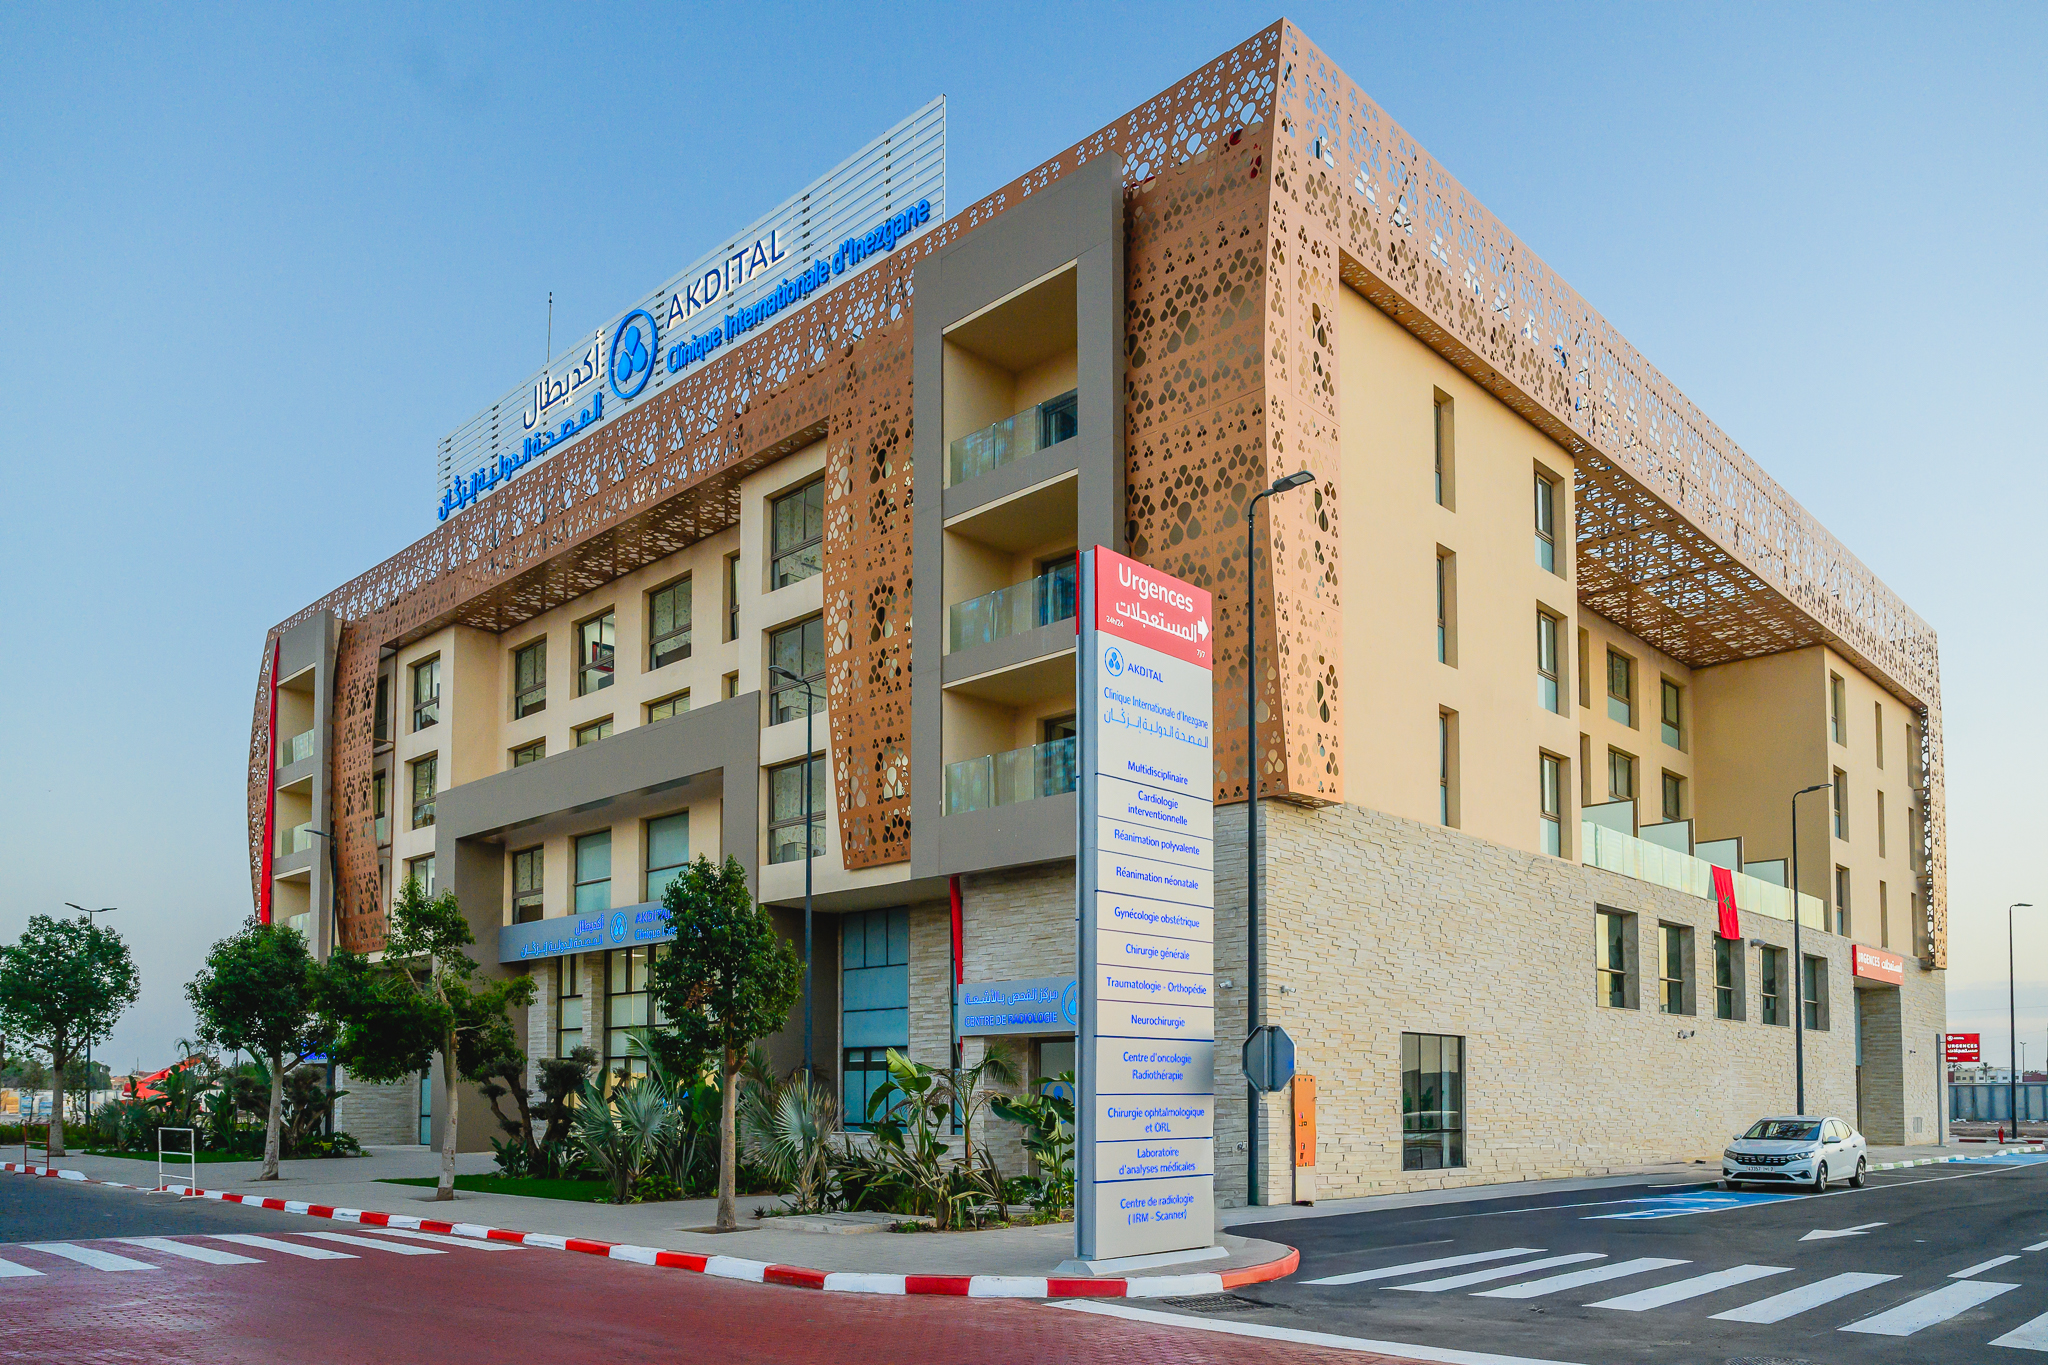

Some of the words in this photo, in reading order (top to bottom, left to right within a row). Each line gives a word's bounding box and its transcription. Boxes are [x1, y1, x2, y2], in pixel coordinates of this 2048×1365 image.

[667, 230, 786, 328] AKDITAL
[667, 326, 722, 373] Clinique
[724, 259, 829, 340] Internationale
[832, 199, 930, 275] d'Inezgane
[523, 330, 602, 430] أكديطال
[532, 392, 602, 457] المصحة
[477, 437, 532, 491] الدولية
[1119, 563, 1193, 612] Urgences
[1106, 615, 1124, 627] 24h/24
[1116, 601, 1197, 643] المستعجلات
[1127, 663, 1163, 683] AKDITAL
[1104, 687, 1131, 704] Clinique
[1133, 696, 1175, 718] Internationale
[1177, 711, 1208, 729] d'Inezgane
[1142, 718, 1173, 738] الدولية
[1175, 728, 1208, 748] المصحة
[1128, 760, 1188, 785] Multidisciplinaire
[1138, 790, 1178, 810] Cardiologie
[1128, 803, 1187, 826] interventionnelle
[1114, 829, 1160, 847] Réanimation
[1161, 840, 1200, 855] polyvalente
[1116, 866, 1162, 883] Réanimation
[1164, 875, 1199, 889] néonatale
[635, 909, 673, 924] AKDITAL
[1114, 906, 1159, 924] Gynécologie
[1161, 913, 1200, 928] obstétrique
[634, 928, 660, 940] Clinique
[1126, 943, 1158, 958] Chirurgie
[1160, 947, 1190, 960] générale
[1857, 953, 1880, 967] URGENCES
[1038, 987, 1058, 1003] مركز
[1107, 977, 1161, 993] Traumatologie
[1168, 982, 1207, 995] Orthopédie
[1008, 988, 1038, 1005] الفحص
[965, 1015, 994, 1027] CENTRE
[996, 1014, 1006, 1025] DE
[1008, 1012, 1058, 1024] RADIOLOGIE
[1131, 1014, 1185, 1029] Neurochirurgie
[1123, 1051, 1148, 1063] Centre
[1150, 1053, 1192, 1066] d'oncologie
[1132, 1069, 1183, 1082] Radiothérapie
[1107, 1107, 1143, 1120] Chirurgie
[1144, 1106, 1205, 1119] ophtalmologique
[1145, 1123, 1152, 1133] et
[1154, 1122, 1171, 1132] ORL
[1137, 1147, 1179, 1158] Laboratoire
[1119, 1164, 1158, 1176] d'analyses
[1160, 1161, 1195, 1173] médicales
[1120, 1197, 1145, 1209] Centre
[1147, 1197, 1157, 1206] de
[1158, 1193, 1194, 1206] radiologie
[1156, 1209, 1187, 1221] Scanner)
